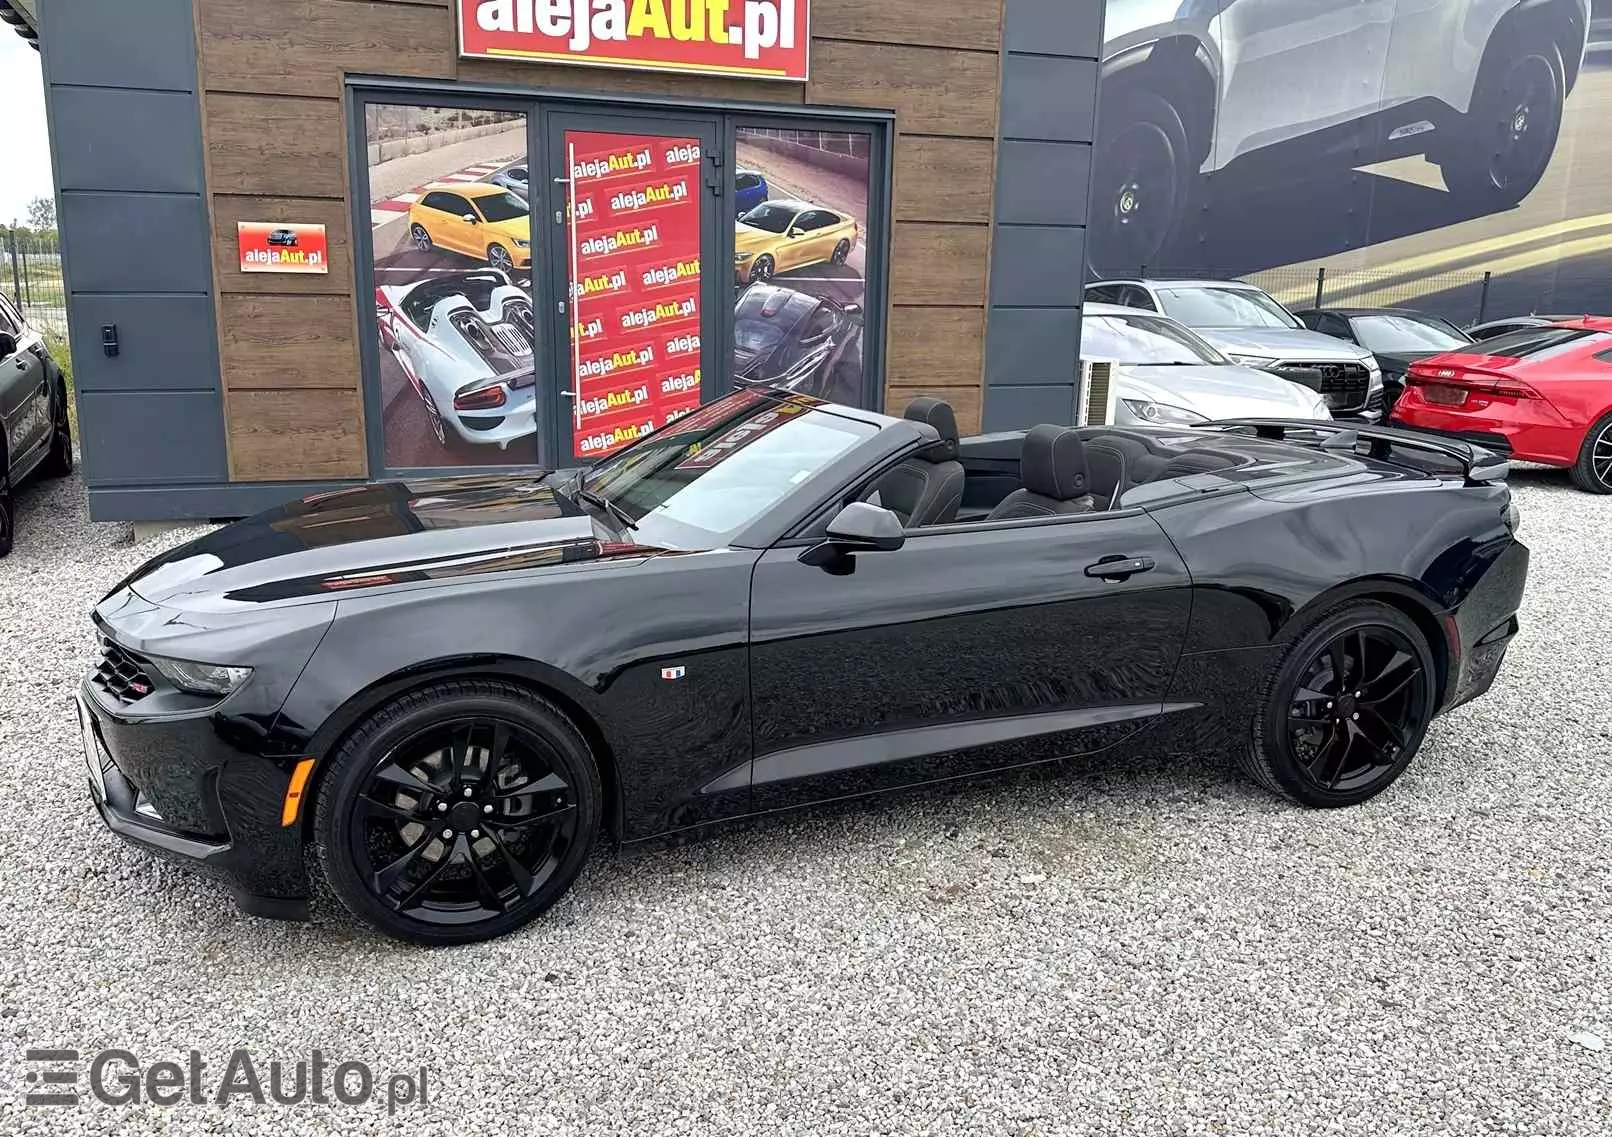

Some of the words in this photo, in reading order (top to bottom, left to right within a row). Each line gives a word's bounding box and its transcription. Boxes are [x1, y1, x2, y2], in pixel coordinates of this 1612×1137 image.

[574, 149, 651, 178] alejaAut.pl
[665, 143, 700, 164] aleja
[610, 181, 688, 210] alejaAut.pl
[580, 225, 658, 256] alejaAut.pl
[245, 248, 322, 265] alejaAut.pl
[642, 259, 700, 286] alejaAut
[621, 298, 697, 328] alejaAut.pl
[666, 335, 700, 354] aleja
[578, 347, 654, 377] alejaAut.pl
[580, 421, 654, 451] alejaAut.pl
